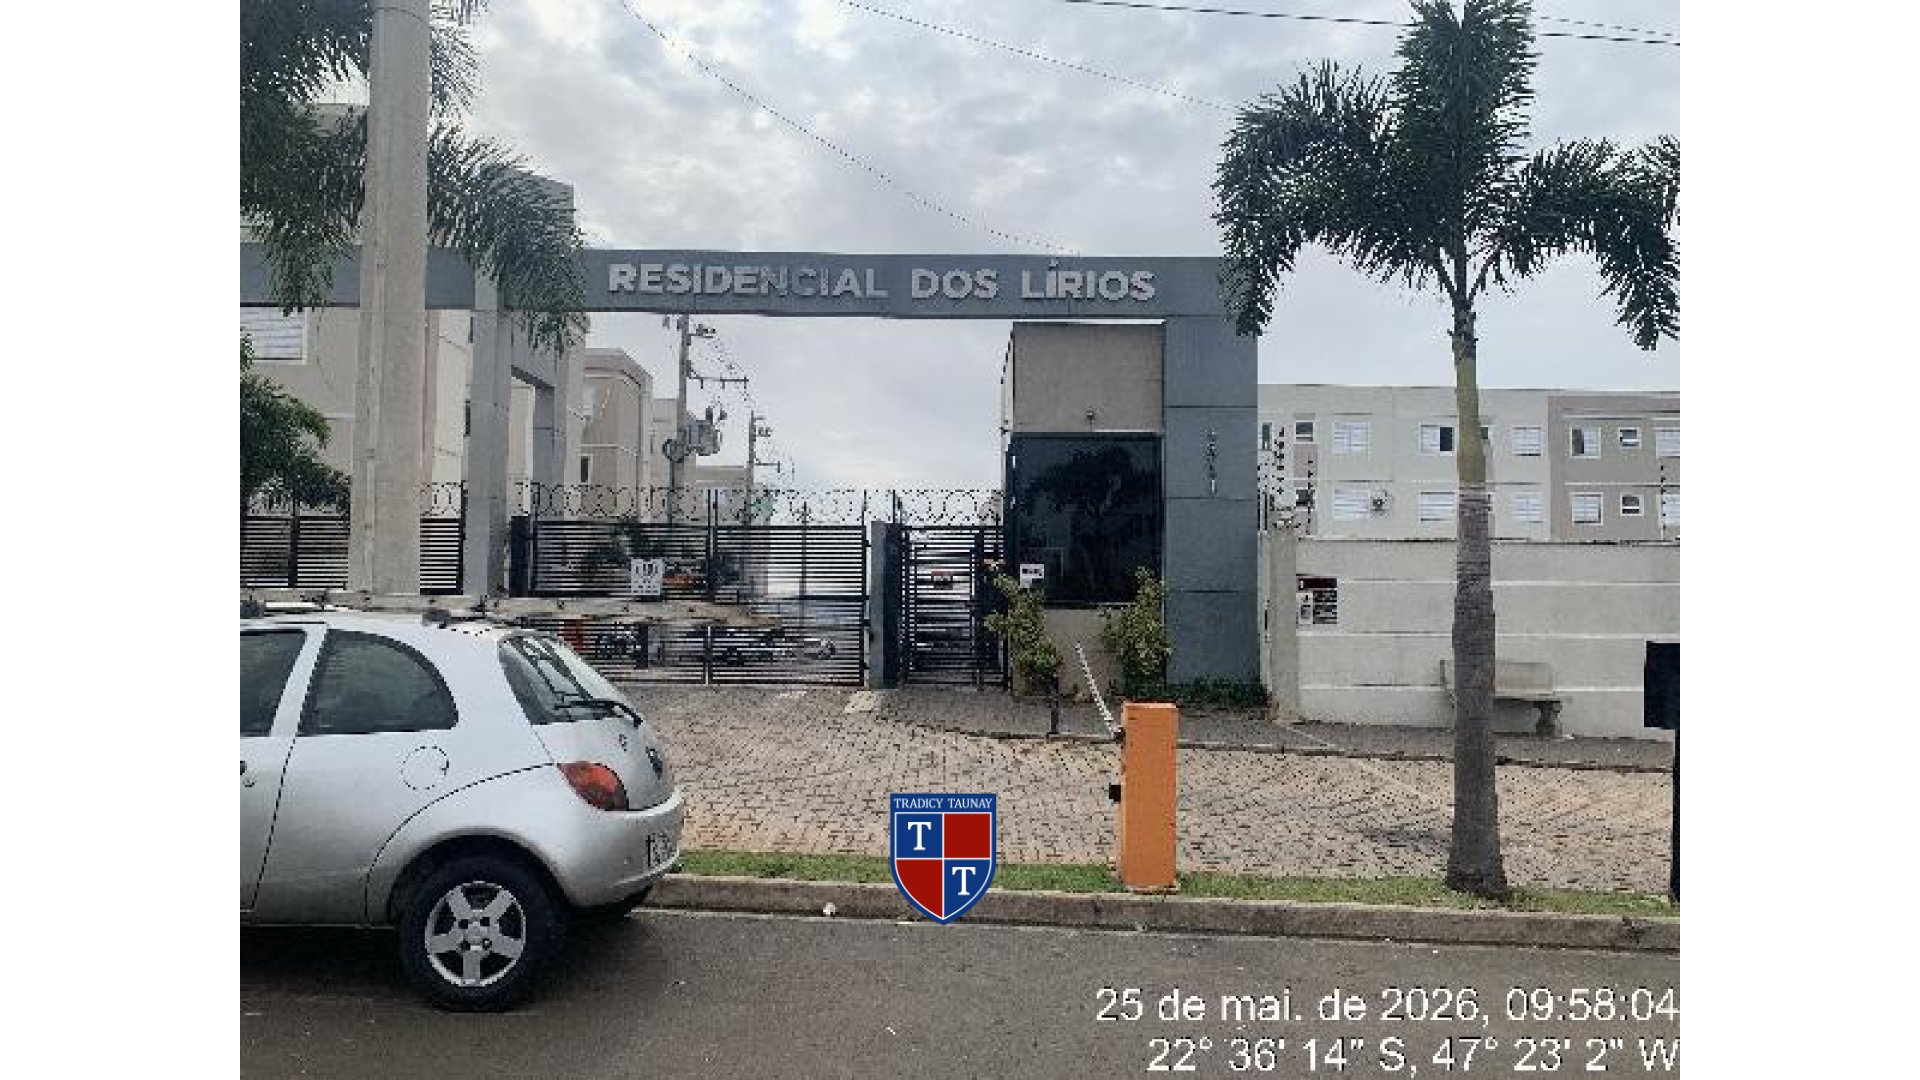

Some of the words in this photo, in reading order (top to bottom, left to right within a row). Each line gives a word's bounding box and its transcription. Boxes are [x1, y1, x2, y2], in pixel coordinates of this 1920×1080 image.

[608, 263, 889, 297] RESIDENCIAL
[911, 268, 999, 299] DOS
[1021, 258, 1156, 301] LÍRIOS
